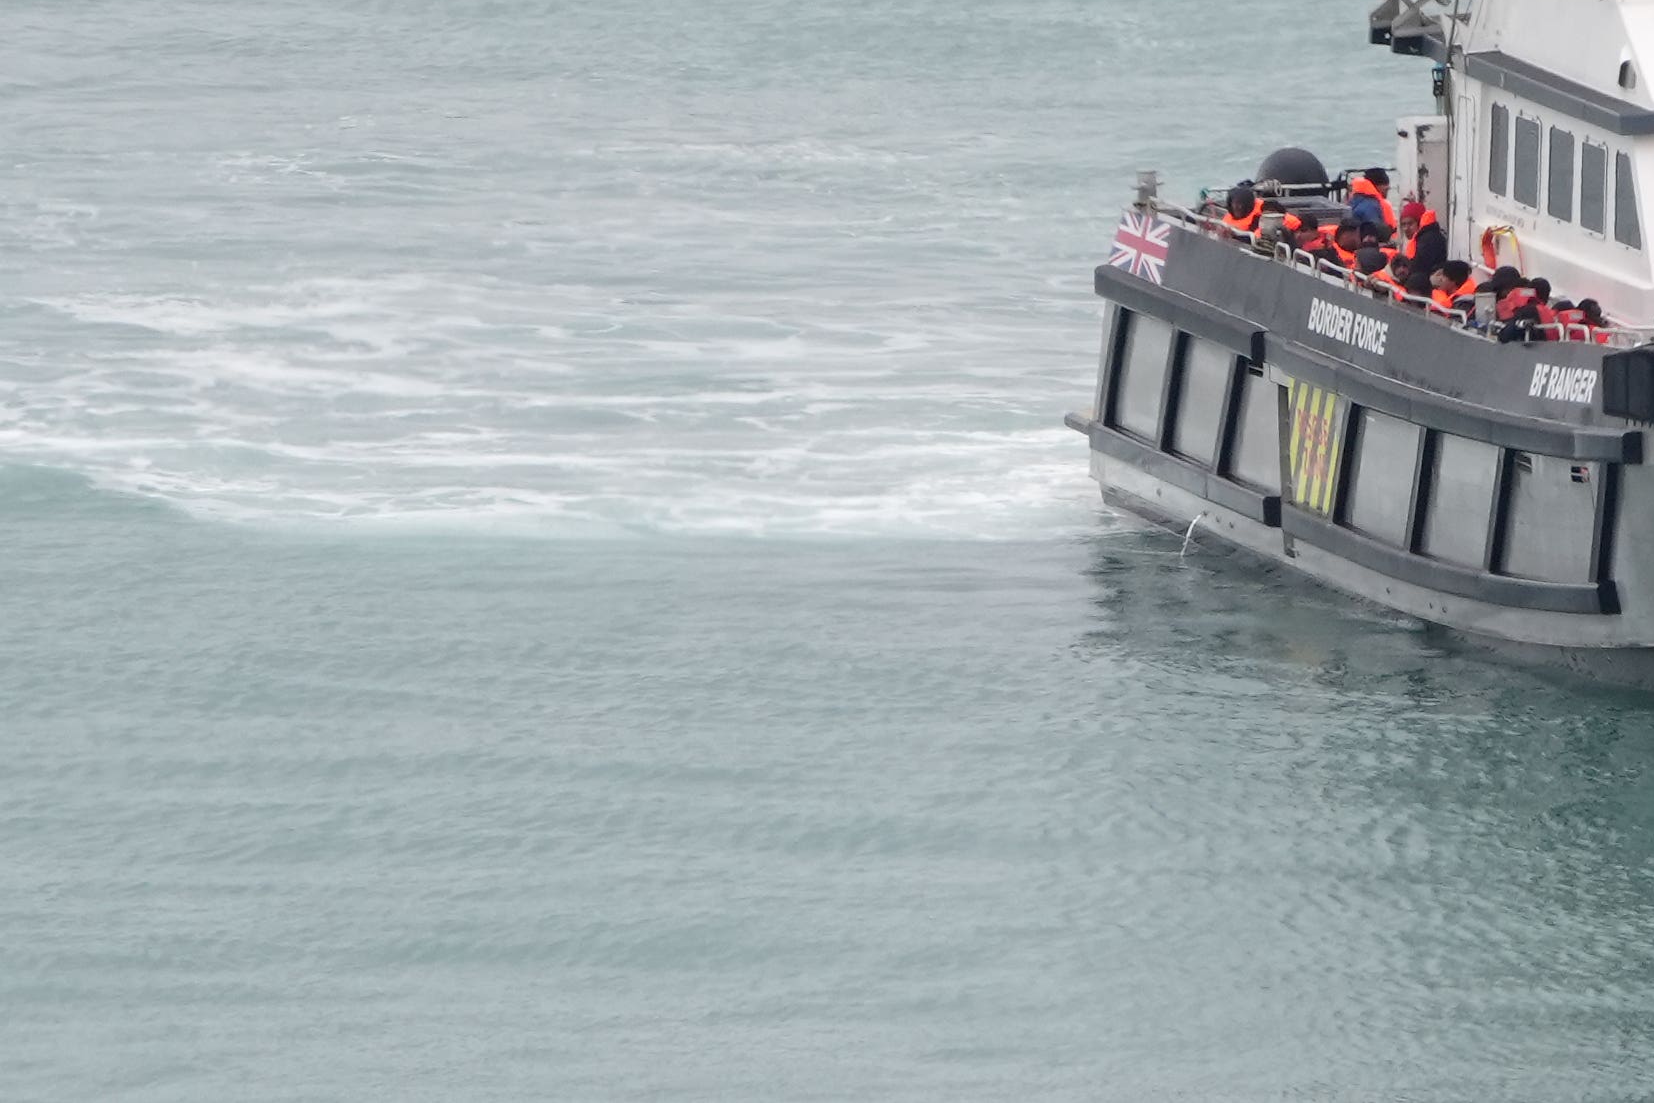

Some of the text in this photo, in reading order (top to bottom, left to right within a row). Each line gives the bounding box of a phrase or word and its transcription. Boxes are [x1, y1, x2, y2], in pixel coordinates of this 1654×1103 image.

[1308, 297, 1389, 356] BORDER FORCE
[1528, 363, 1597, 404] BF RANGER
